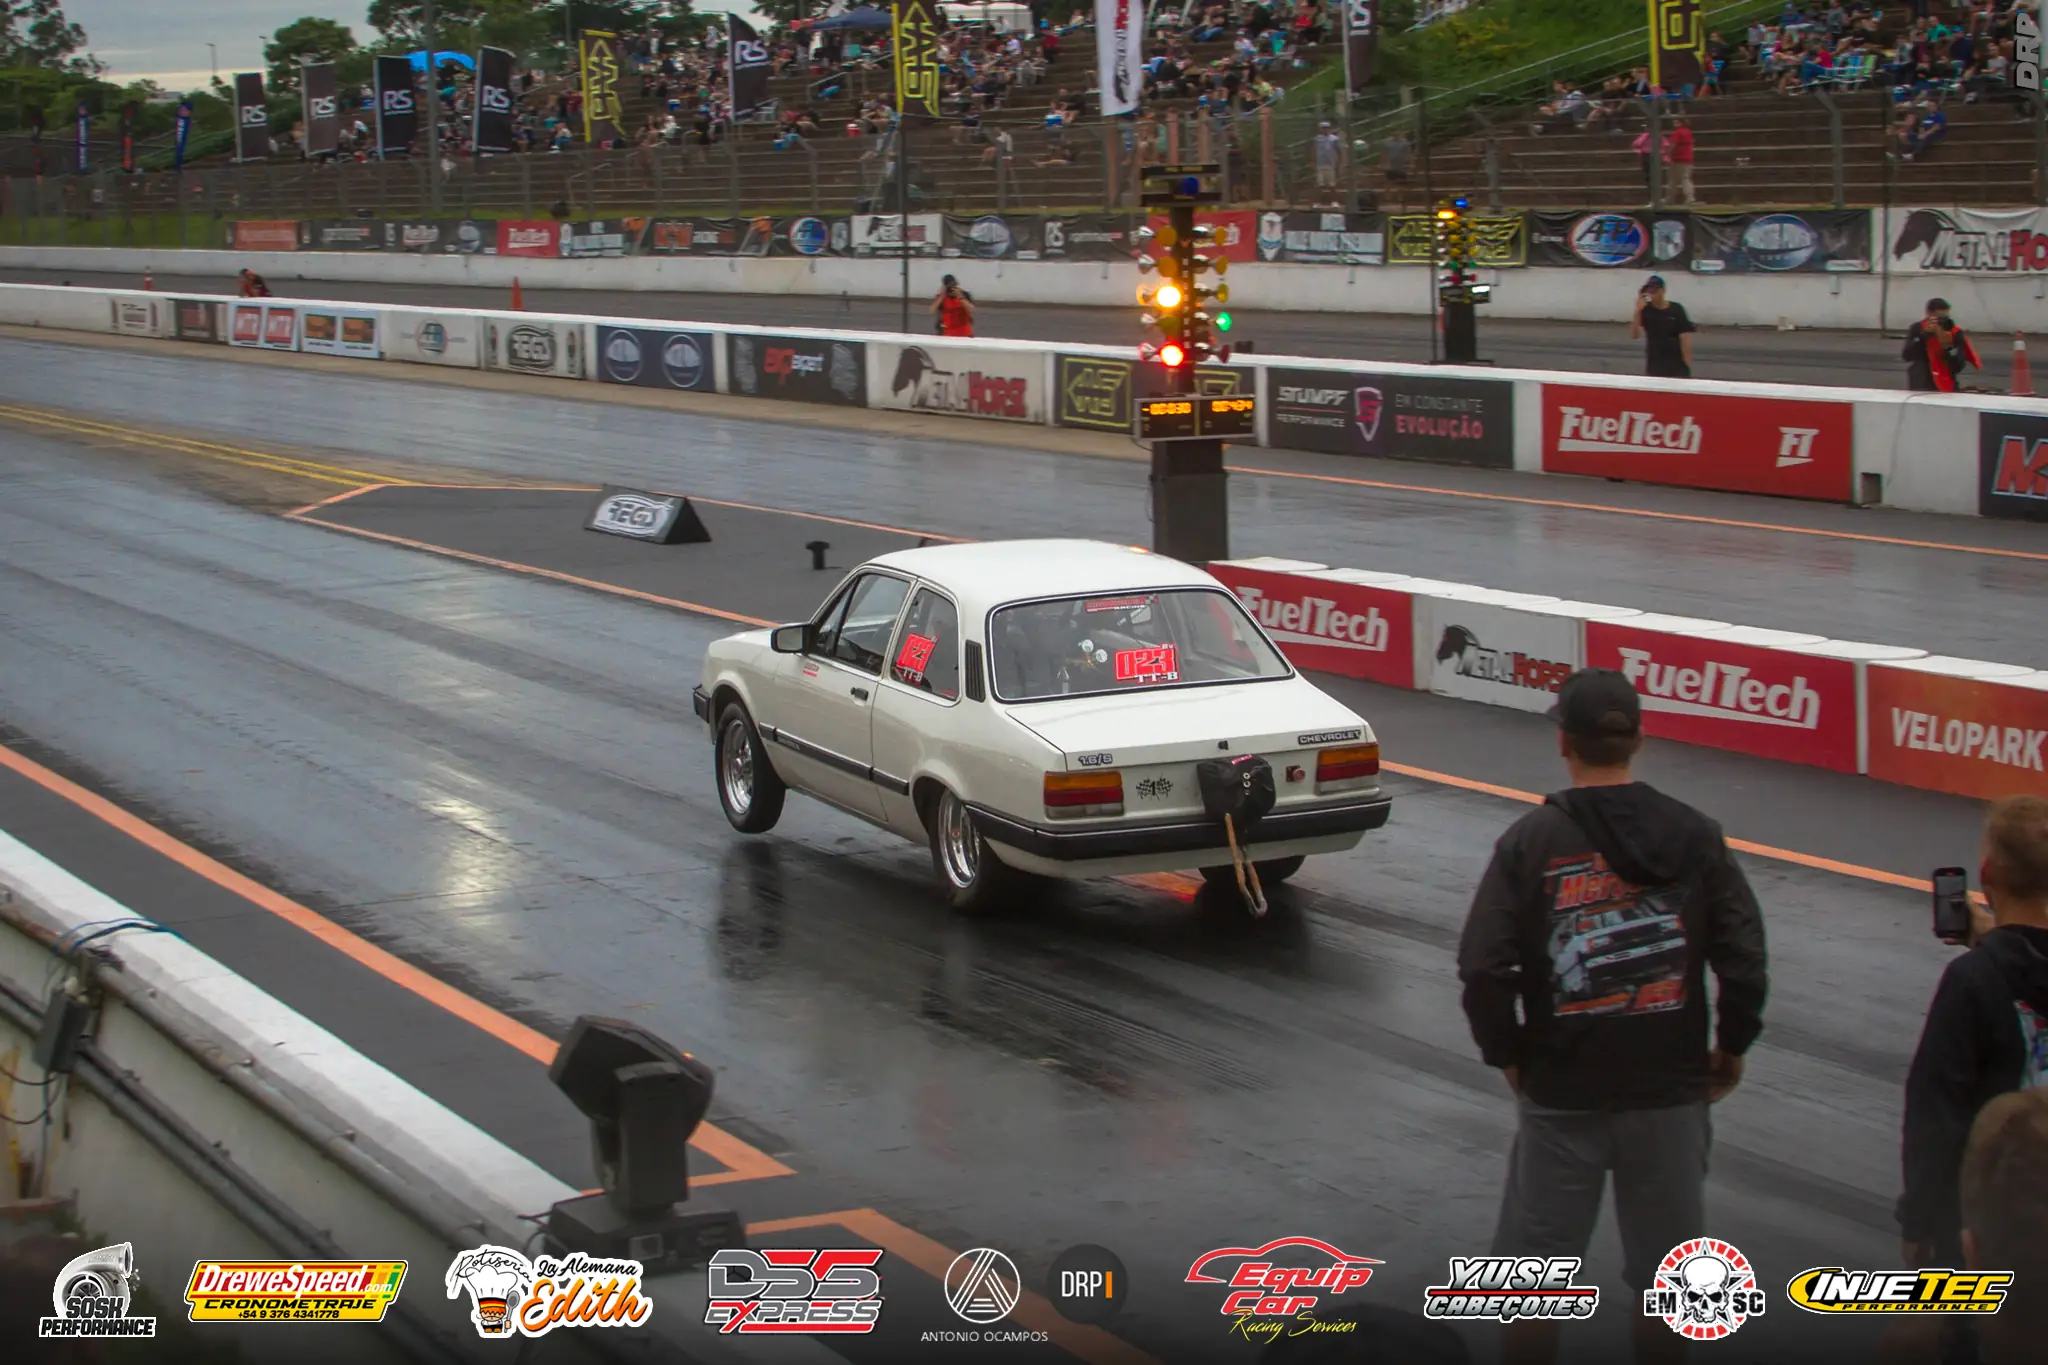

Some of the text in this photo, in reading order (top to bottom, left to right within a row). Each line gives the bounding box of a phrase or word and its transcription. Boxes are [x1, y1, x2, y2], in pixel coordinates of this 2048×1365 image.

[383, 90, 412, 111] RS
[482, 85, 510, 108] RS
[241, 105, 267, 125] RS
[1277, 386, 1349, 406] STUMPF
[1395, 394, 1483, 413] EM CONSTANTE
[1395, 415, 1483, 440] EVOLUÇÃO
[1558, 405, 1702, 453] FuelTech
[1236, 586, 1390, 651] FuelTech
[1618, 647, 1821, 729] FuelTech
[1299, 729, 1361, 744] CHEVROLET
[1891, 707, 2047, 772] VELOPARK
